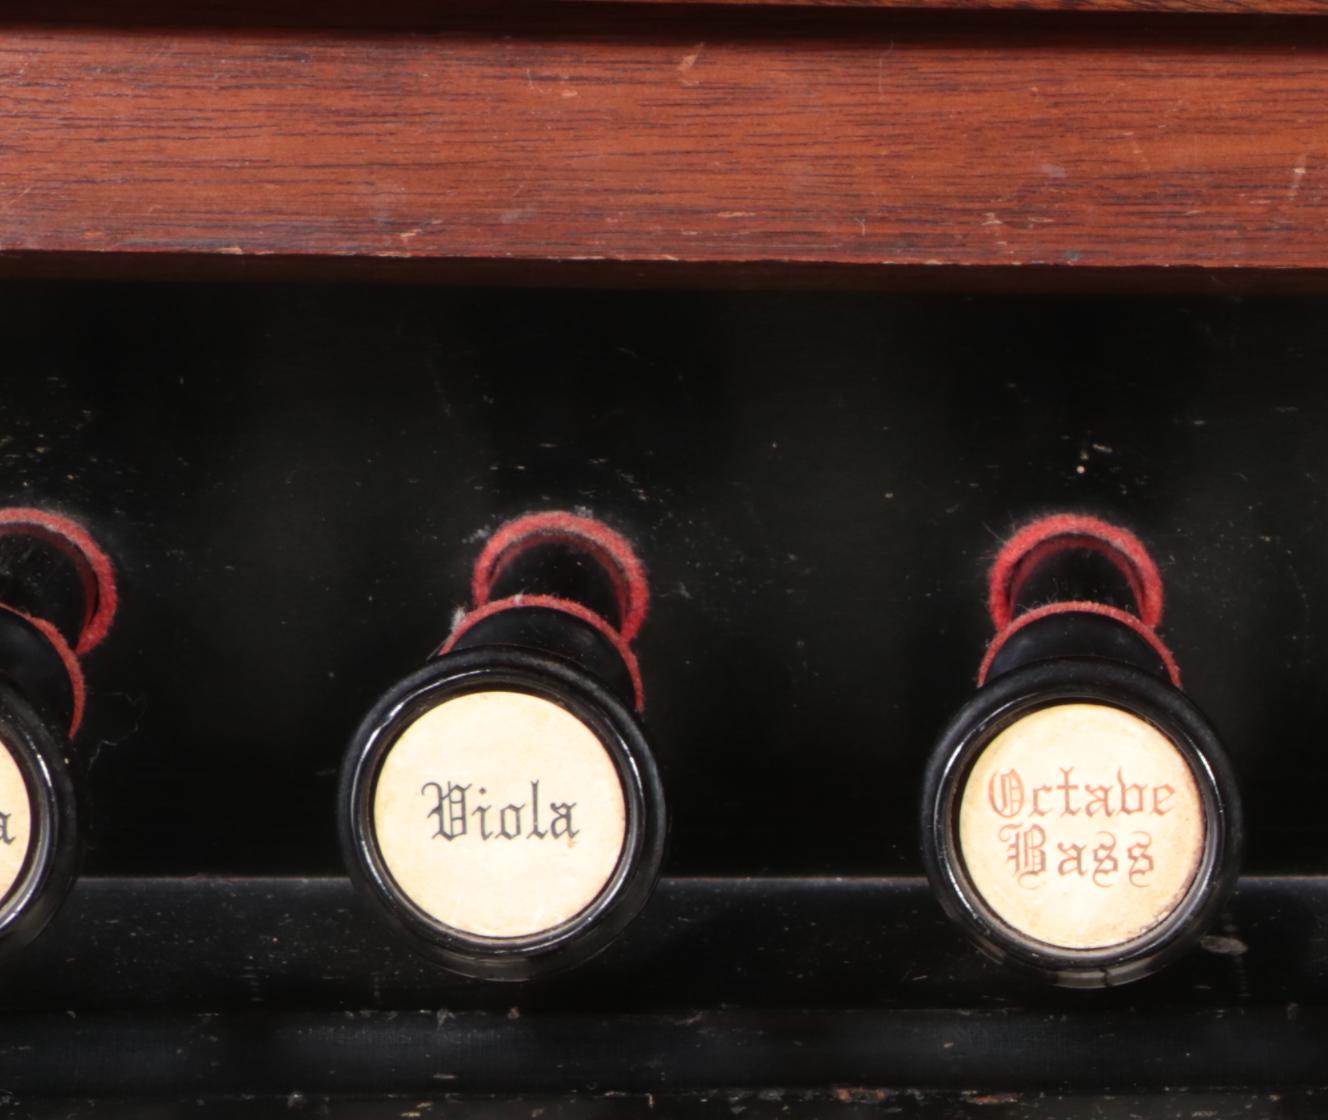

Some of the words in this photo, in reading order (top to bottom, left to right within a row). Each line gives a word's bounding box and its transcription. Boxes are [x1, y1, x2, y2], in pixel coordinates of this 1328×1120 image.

[421, 779, 580, 842] Viola
[987, 766, 1175, 818] Octave
[998, 823, 1155, 889] Bass
